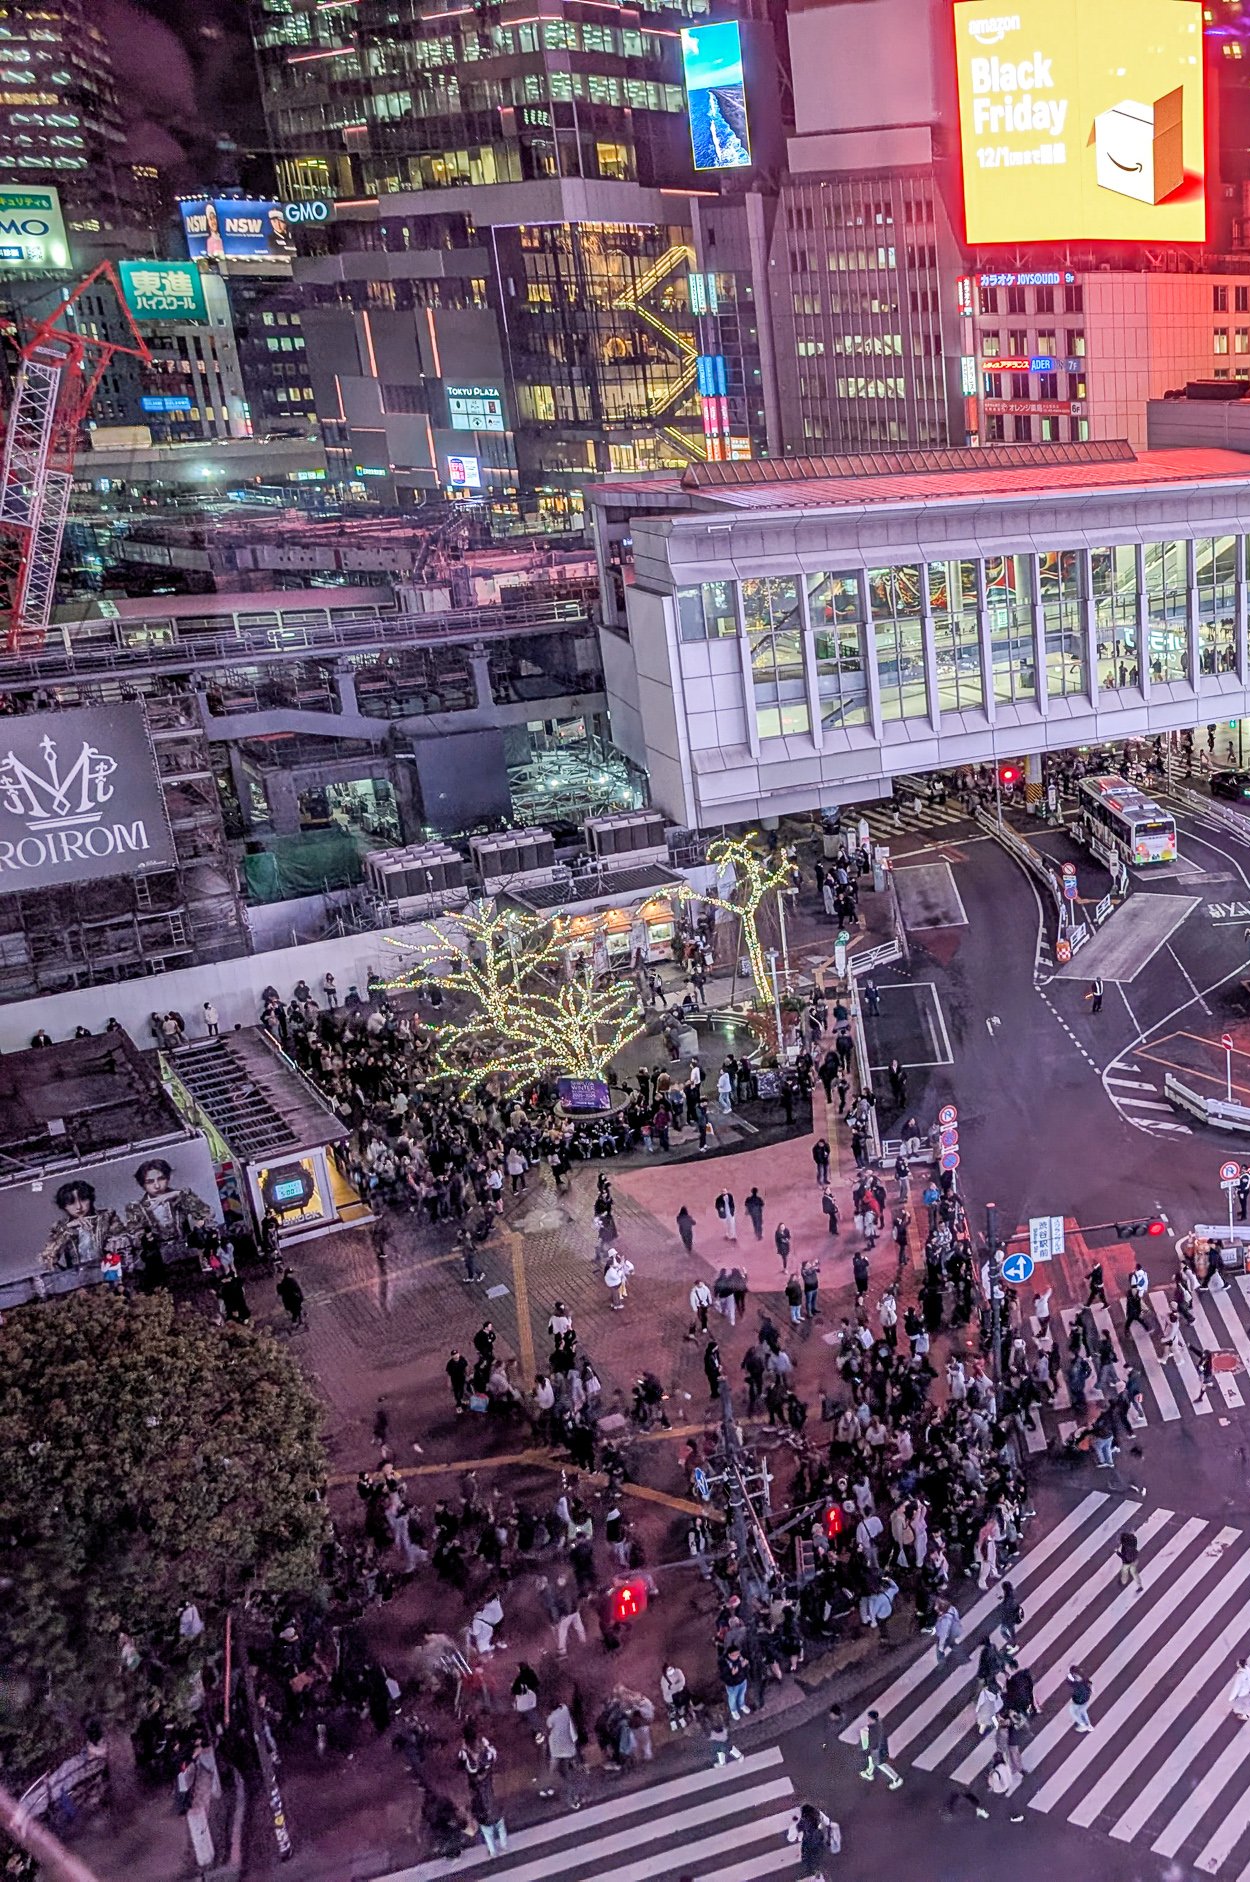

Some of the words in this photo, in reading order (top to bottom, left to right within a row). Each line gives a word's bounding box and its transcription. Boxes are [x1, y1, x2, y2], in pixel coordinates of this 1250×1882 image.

[968, 14, 1021, 38] amazon
[970, 51, 1054, 94] Black
[973, 93, 1068, 136] Friday
[285, 201, 327, 223] GMO
[186, 215, 207, 233] NSW
[225, 218, 262, 233] NSW
[130, 271, 194, 297] 東進
[981, 274, 1015, 286] カラオケ
[1017, 273, 1060, 285] JOYSOUND
[1065, 273, 1075, 283] 9F
[136, 297, 196, 310] ハイスクール
[1068, 360, 1077, 370] 7F
[447, 386, 472, 396] TOKYU
[473, 387, 500, 397] PLAZA
[1072, 404, 1081, 413] 6F
